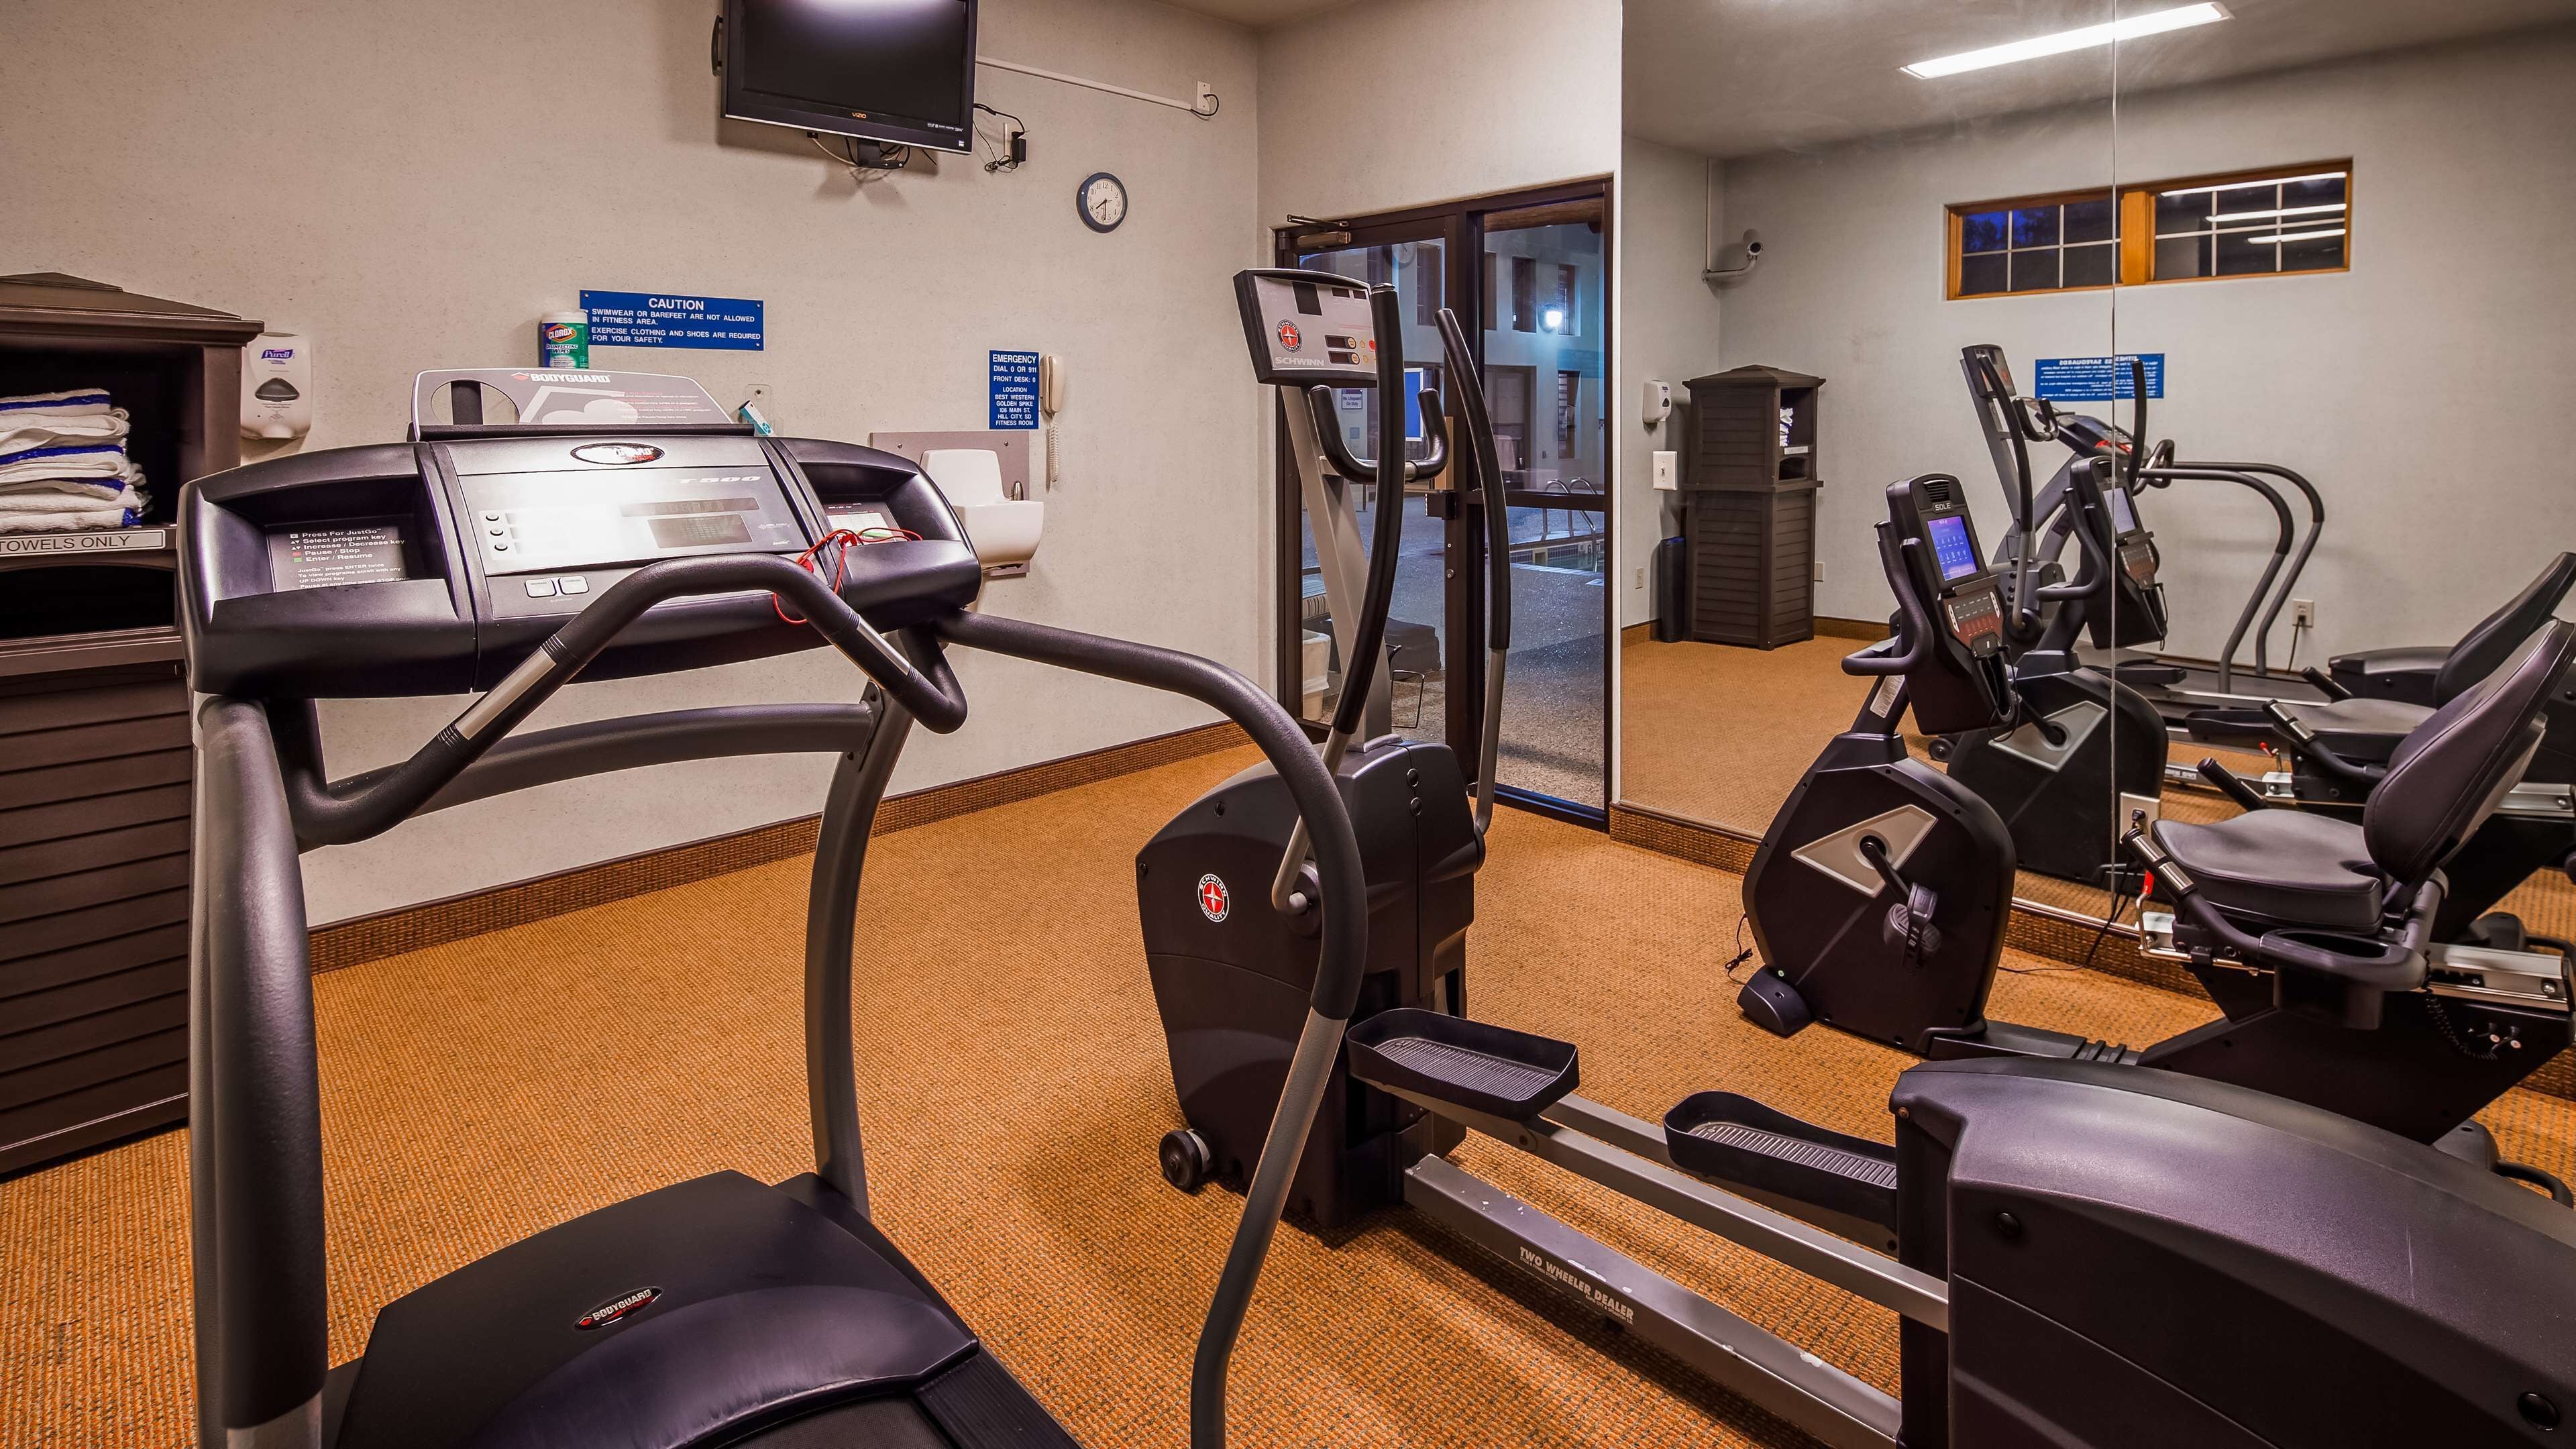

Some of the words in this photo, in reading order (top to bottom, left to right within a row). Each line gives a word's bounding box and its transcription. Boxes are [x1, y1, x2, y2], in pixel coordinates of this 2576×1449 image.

[648, 297, 704, 311] CAUTION
[591, 308, 634, 317] SWIMWEAR
[548, 327, 573, 339] CLOROX
[1281, 341, 1301, 352] QUALITY
[992, 354, 1036, 364] EMERGENCY
[1275, 356, 1325, 366] SCHWINN
[529, 373, 609, 382] BODYGUARD
[1935, 502, 1951, 511] SOLE
[81, 535, 131, 548] ONLY
[1199, 875, 1227, 897] SCHWINN
[1201, 903, 1226, 920] QUALITY
[1519, 1246, 1543, 1267] TWO
[1546, 1261, 1591, 1296] WHEELER
[1594, 1289, 1634, 1321] DEALER
[592, 1289, 653, 1321] BODYGUARD
